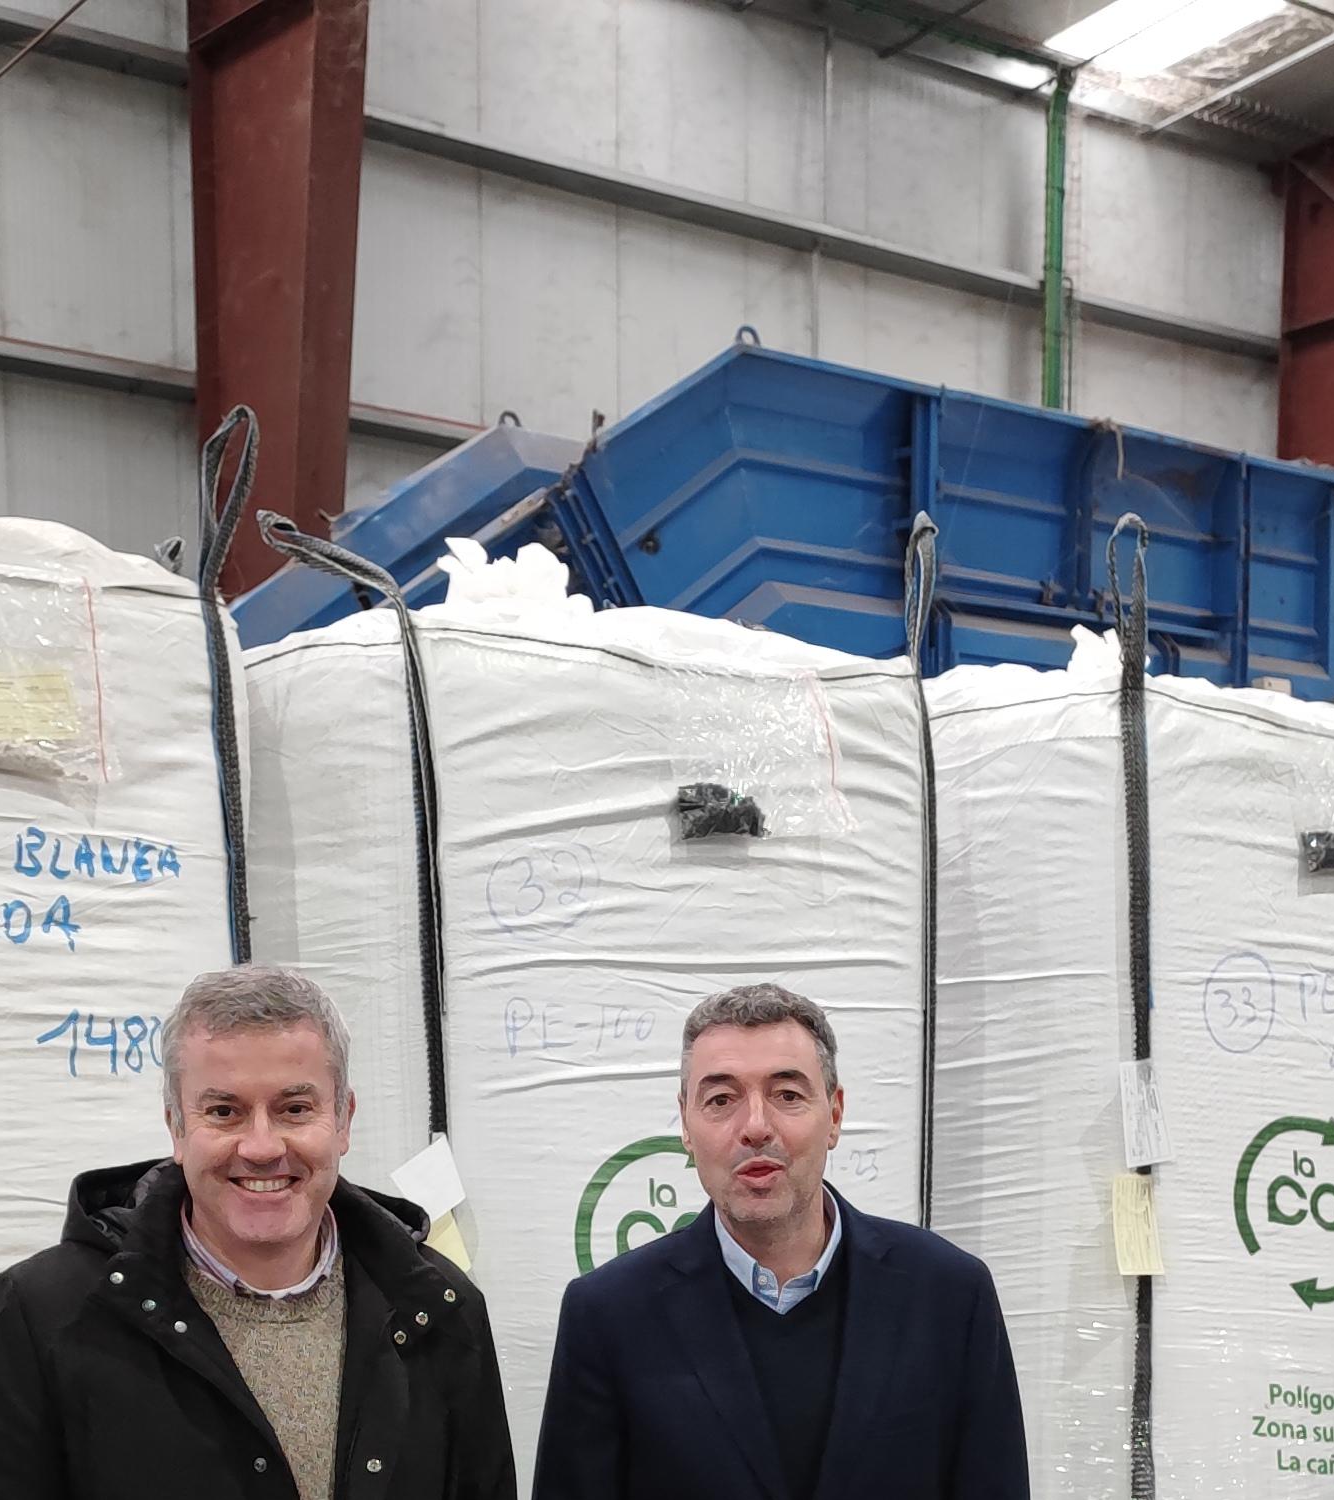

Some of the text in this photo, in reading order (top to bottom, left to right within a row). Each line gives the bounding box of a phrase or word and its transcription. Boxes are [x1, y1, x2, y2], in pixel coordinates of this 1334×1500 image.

[1213, 985, 1258, 1029] 33
[1293, 1150, 1316, 1179] la
[649, 1177, 678, 1208] la
[1252, 1415, 1307, 1440] Zona
[1277, 1449, 1301, 1472] La
